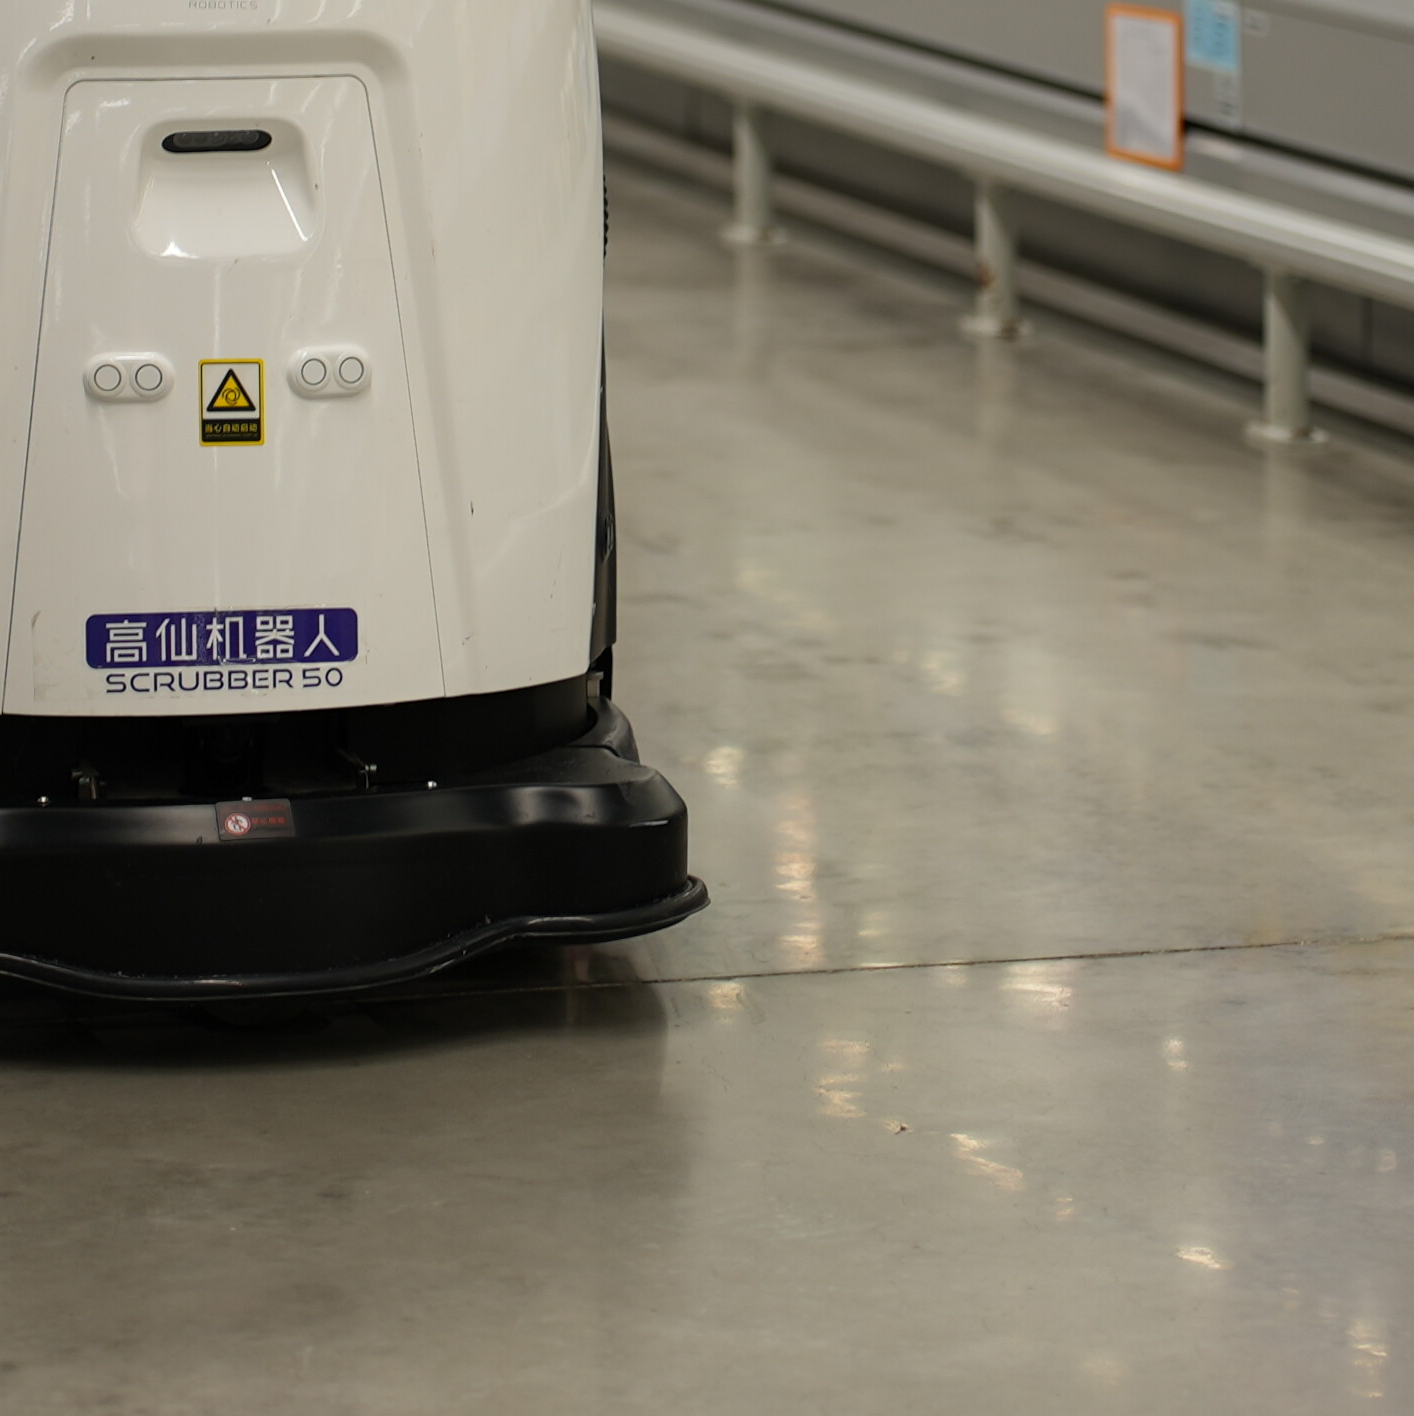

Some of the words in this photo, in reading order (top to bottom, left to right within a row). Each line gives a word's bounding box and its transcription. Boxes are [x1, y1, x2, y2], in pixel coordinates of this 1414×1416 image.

[188, 0, 258, 10] ROBOTICS
[105, 613, 342, 664] 高仙机器人
[105, 668, 294, 694] SCRUBBER
[302, 667, 344, 688] 50
